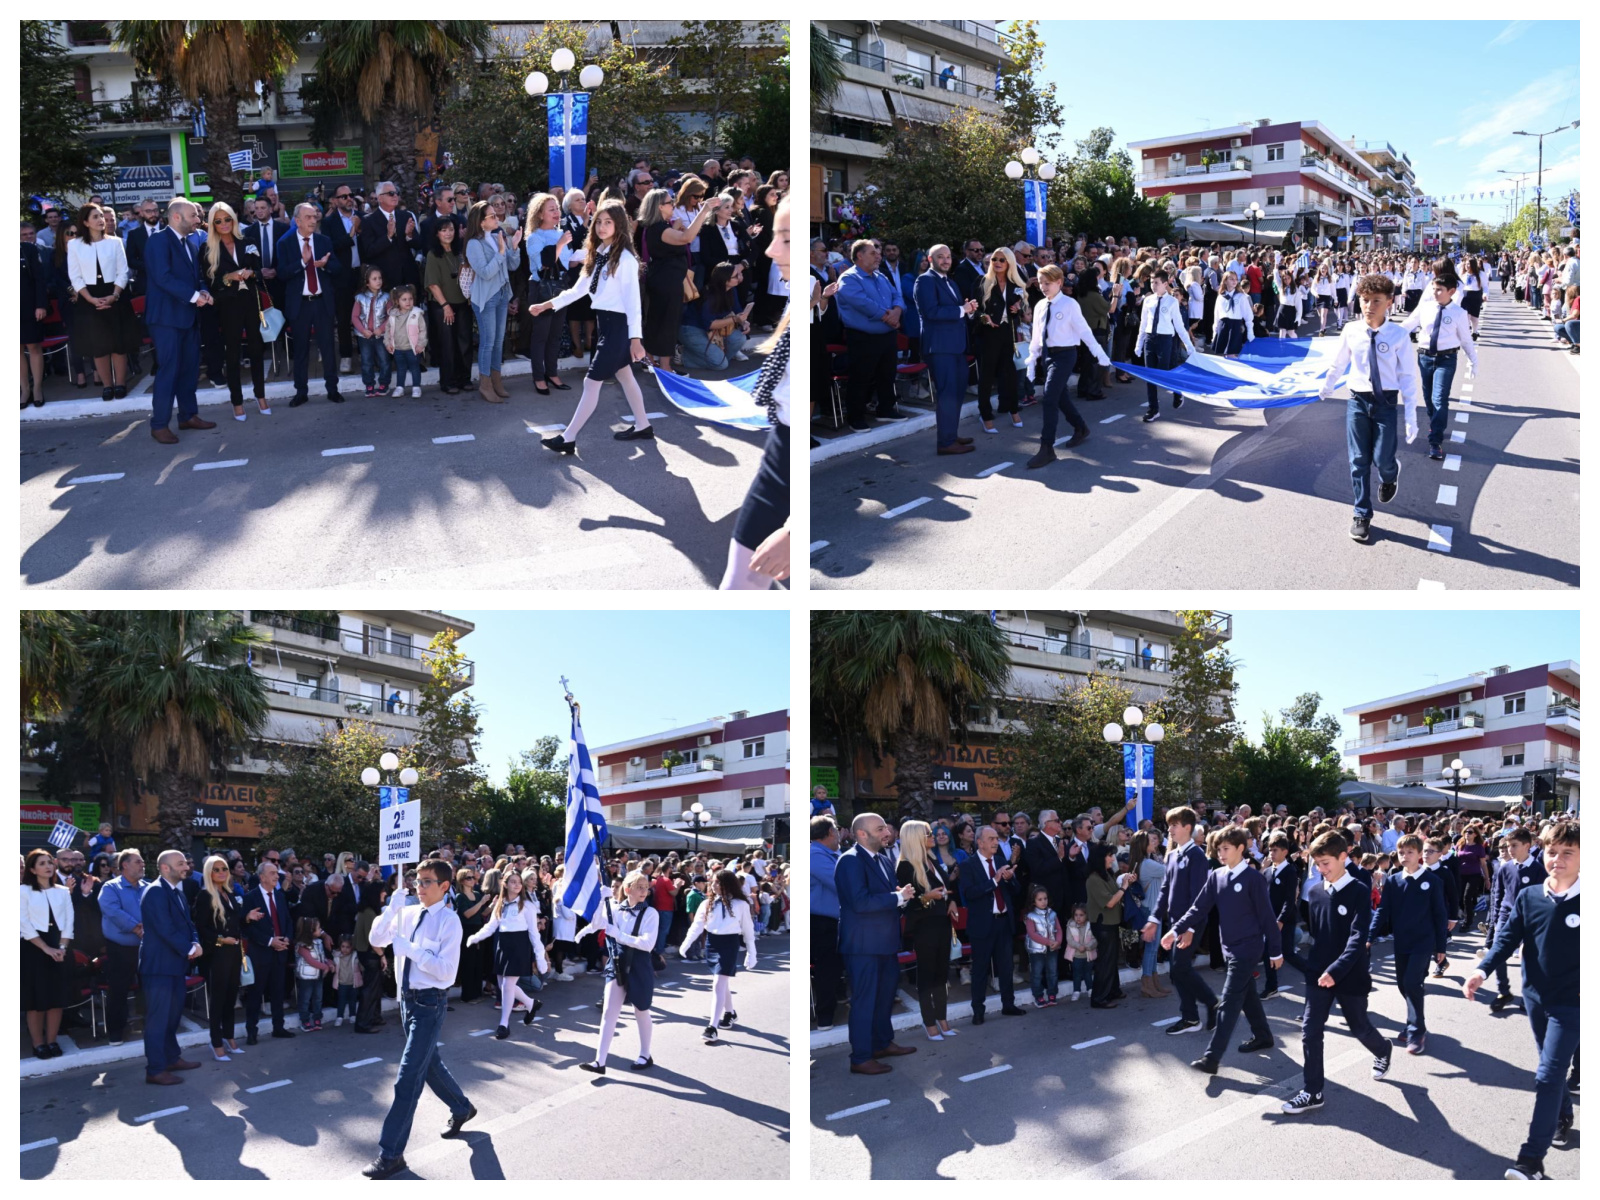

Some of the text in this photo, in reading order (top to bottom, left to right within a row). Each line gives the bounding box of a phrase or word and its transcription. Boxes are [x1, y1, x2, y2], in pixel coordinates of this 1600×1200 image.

[137, 178, 170, 188] σκίασης
[943, 771, 951, 780] Η
[192, 816, 220, 826] ΕΥΚΗ
[386, 830, 414, 842] ΔΗΜΟΤΙΚΟ
[388, 841, 410, 850] ΣΧΟΛΕΙΟ
[388, 852, 410, 860] ΠΕΥΚΗΣ
